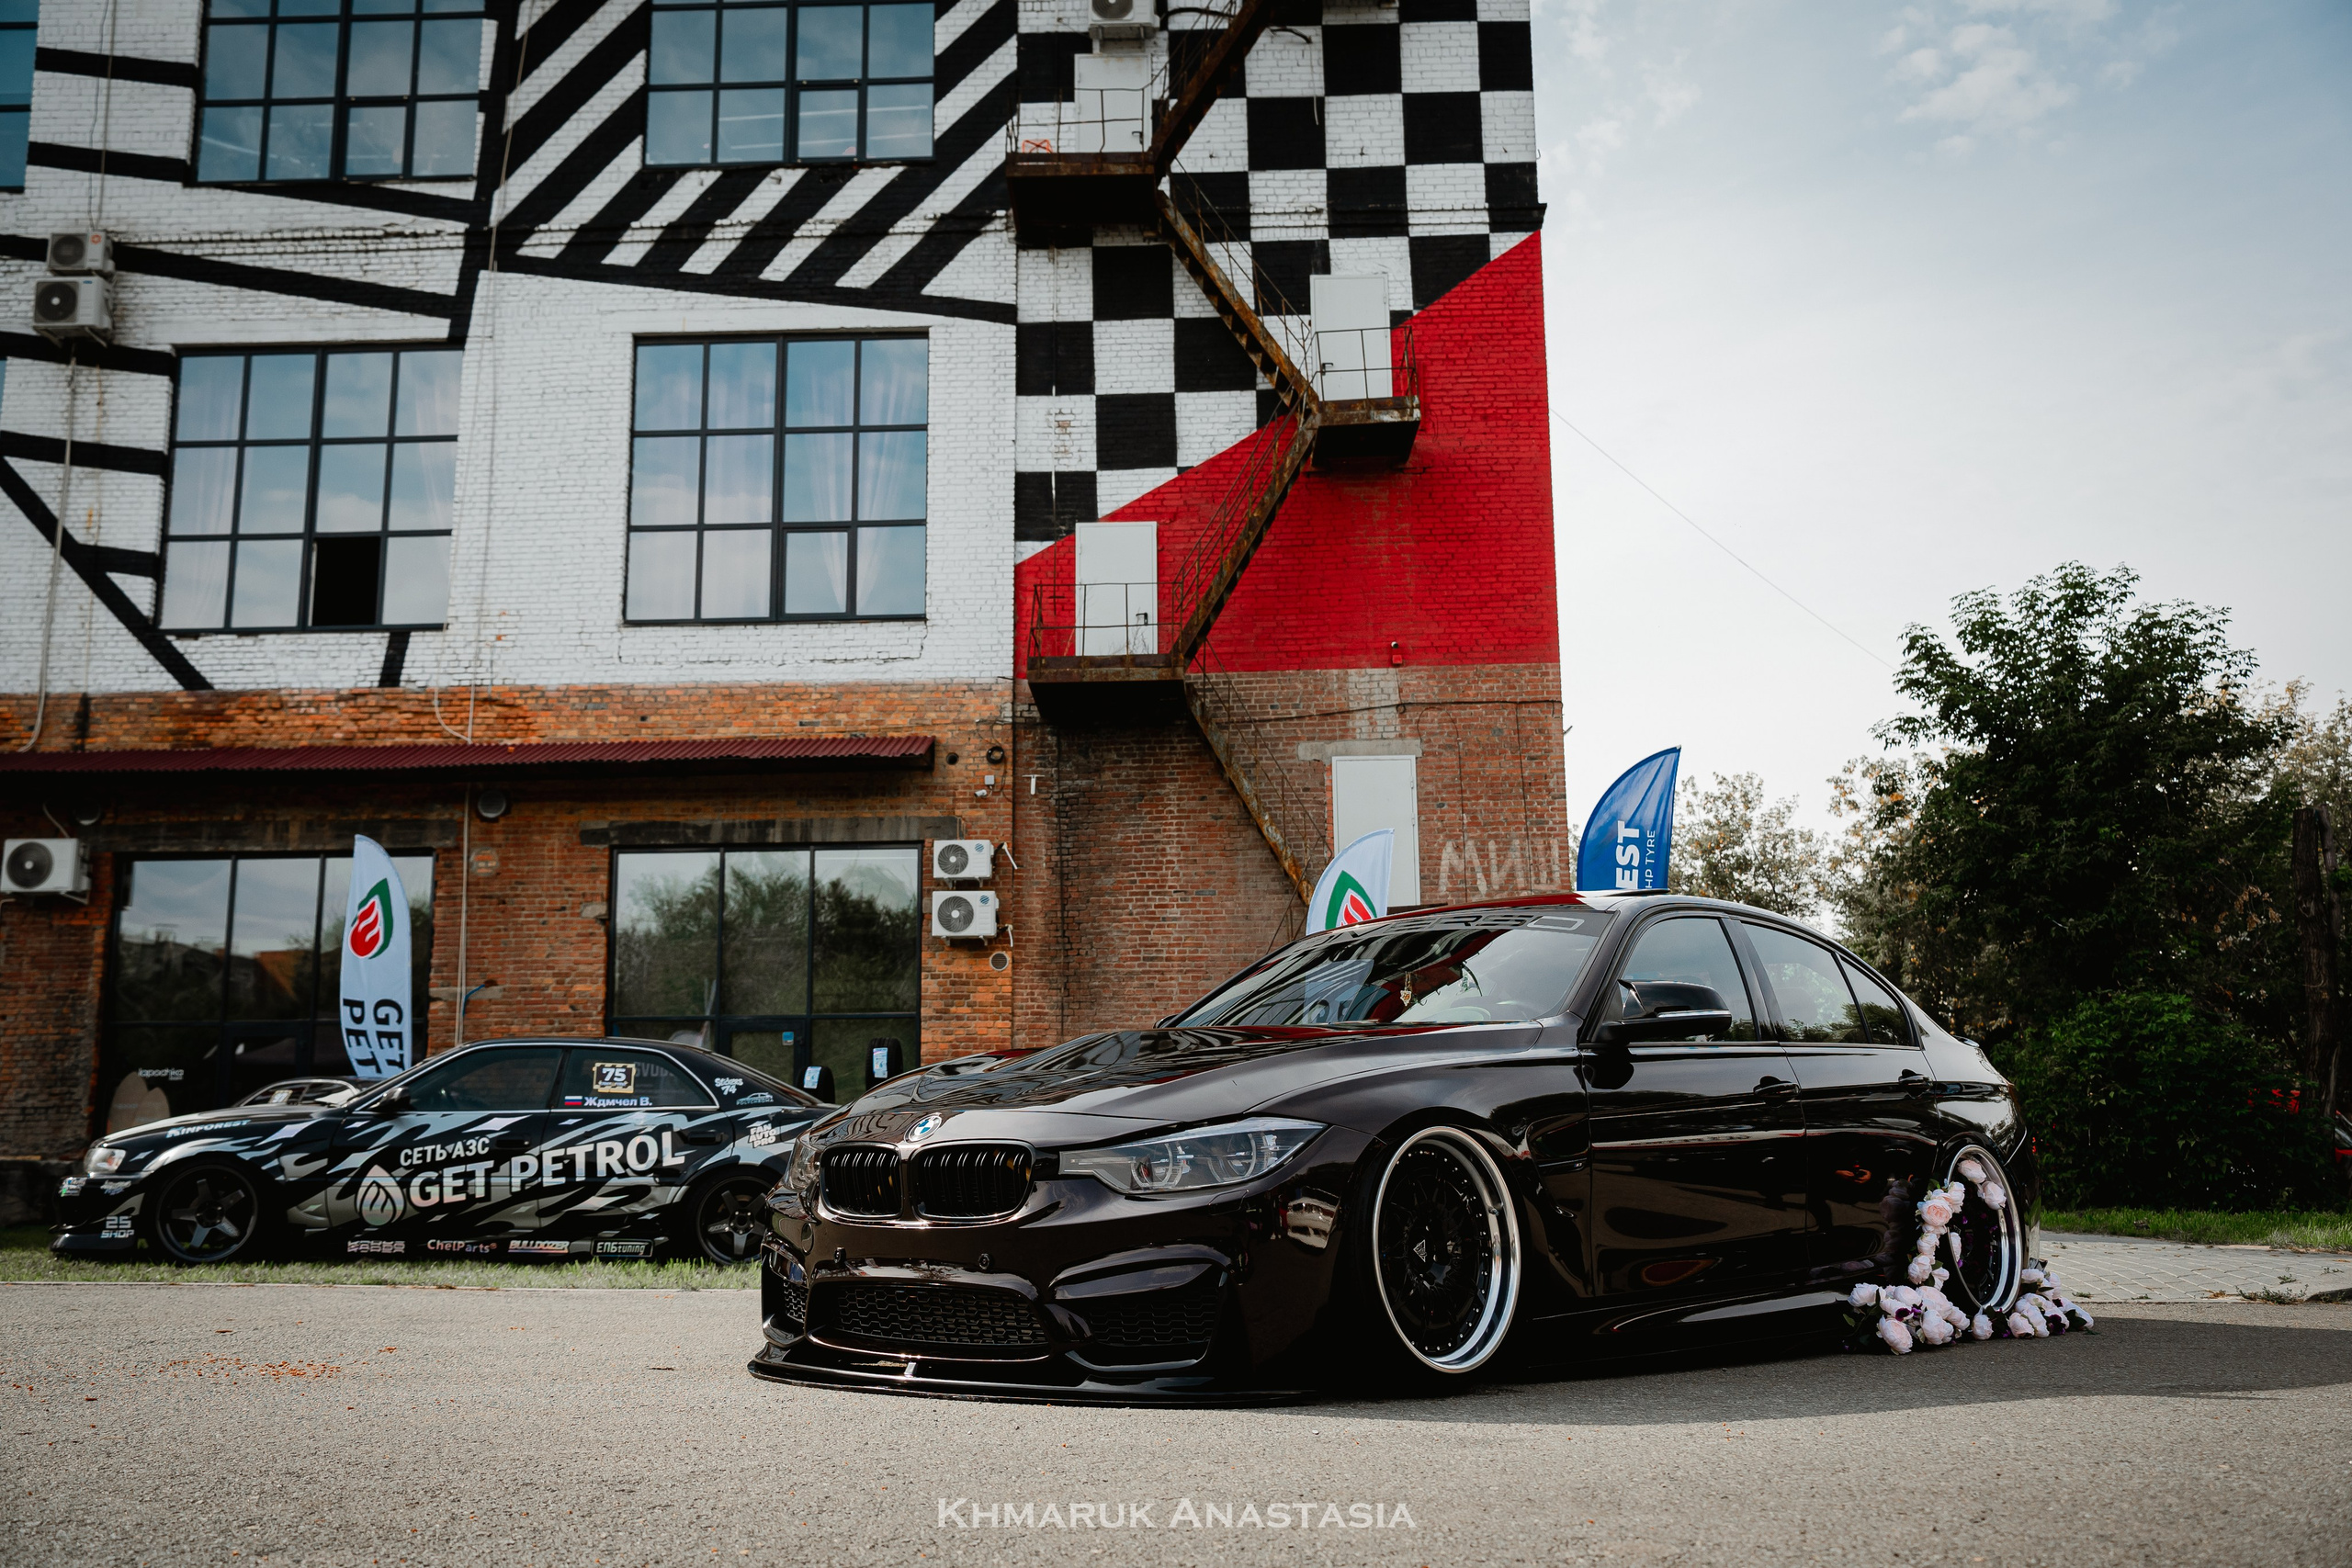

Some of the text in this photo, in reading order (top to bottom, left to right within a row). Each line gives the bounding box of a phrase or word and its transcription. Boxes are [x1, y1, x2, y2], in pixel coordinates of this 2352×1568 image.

[1645, 829, 1656, 865] TYRE
[1615, 819, 1640, 890] EST
[372, 998, 406, 1072] GET
[602, 1067, 627, 1082] 75
[720, 1085, 737, 1096] 74
[639, 1096, 653, 1106] В.
[750, 1123, 773, 1135] FAN
[748, 1129, 778, 1143] AVTO
[752, 1135, 776, 1148] PRO
[400, 1136, 491, 1167] СЕТЬ АЗС
[409, 1131, 685, 1208] GET PETROL
[106, 1216, 131, 1229] 25
[100, 1229, 135, 1238] SHOP
[509, 1240, 570, 1250] BULLDOZER
